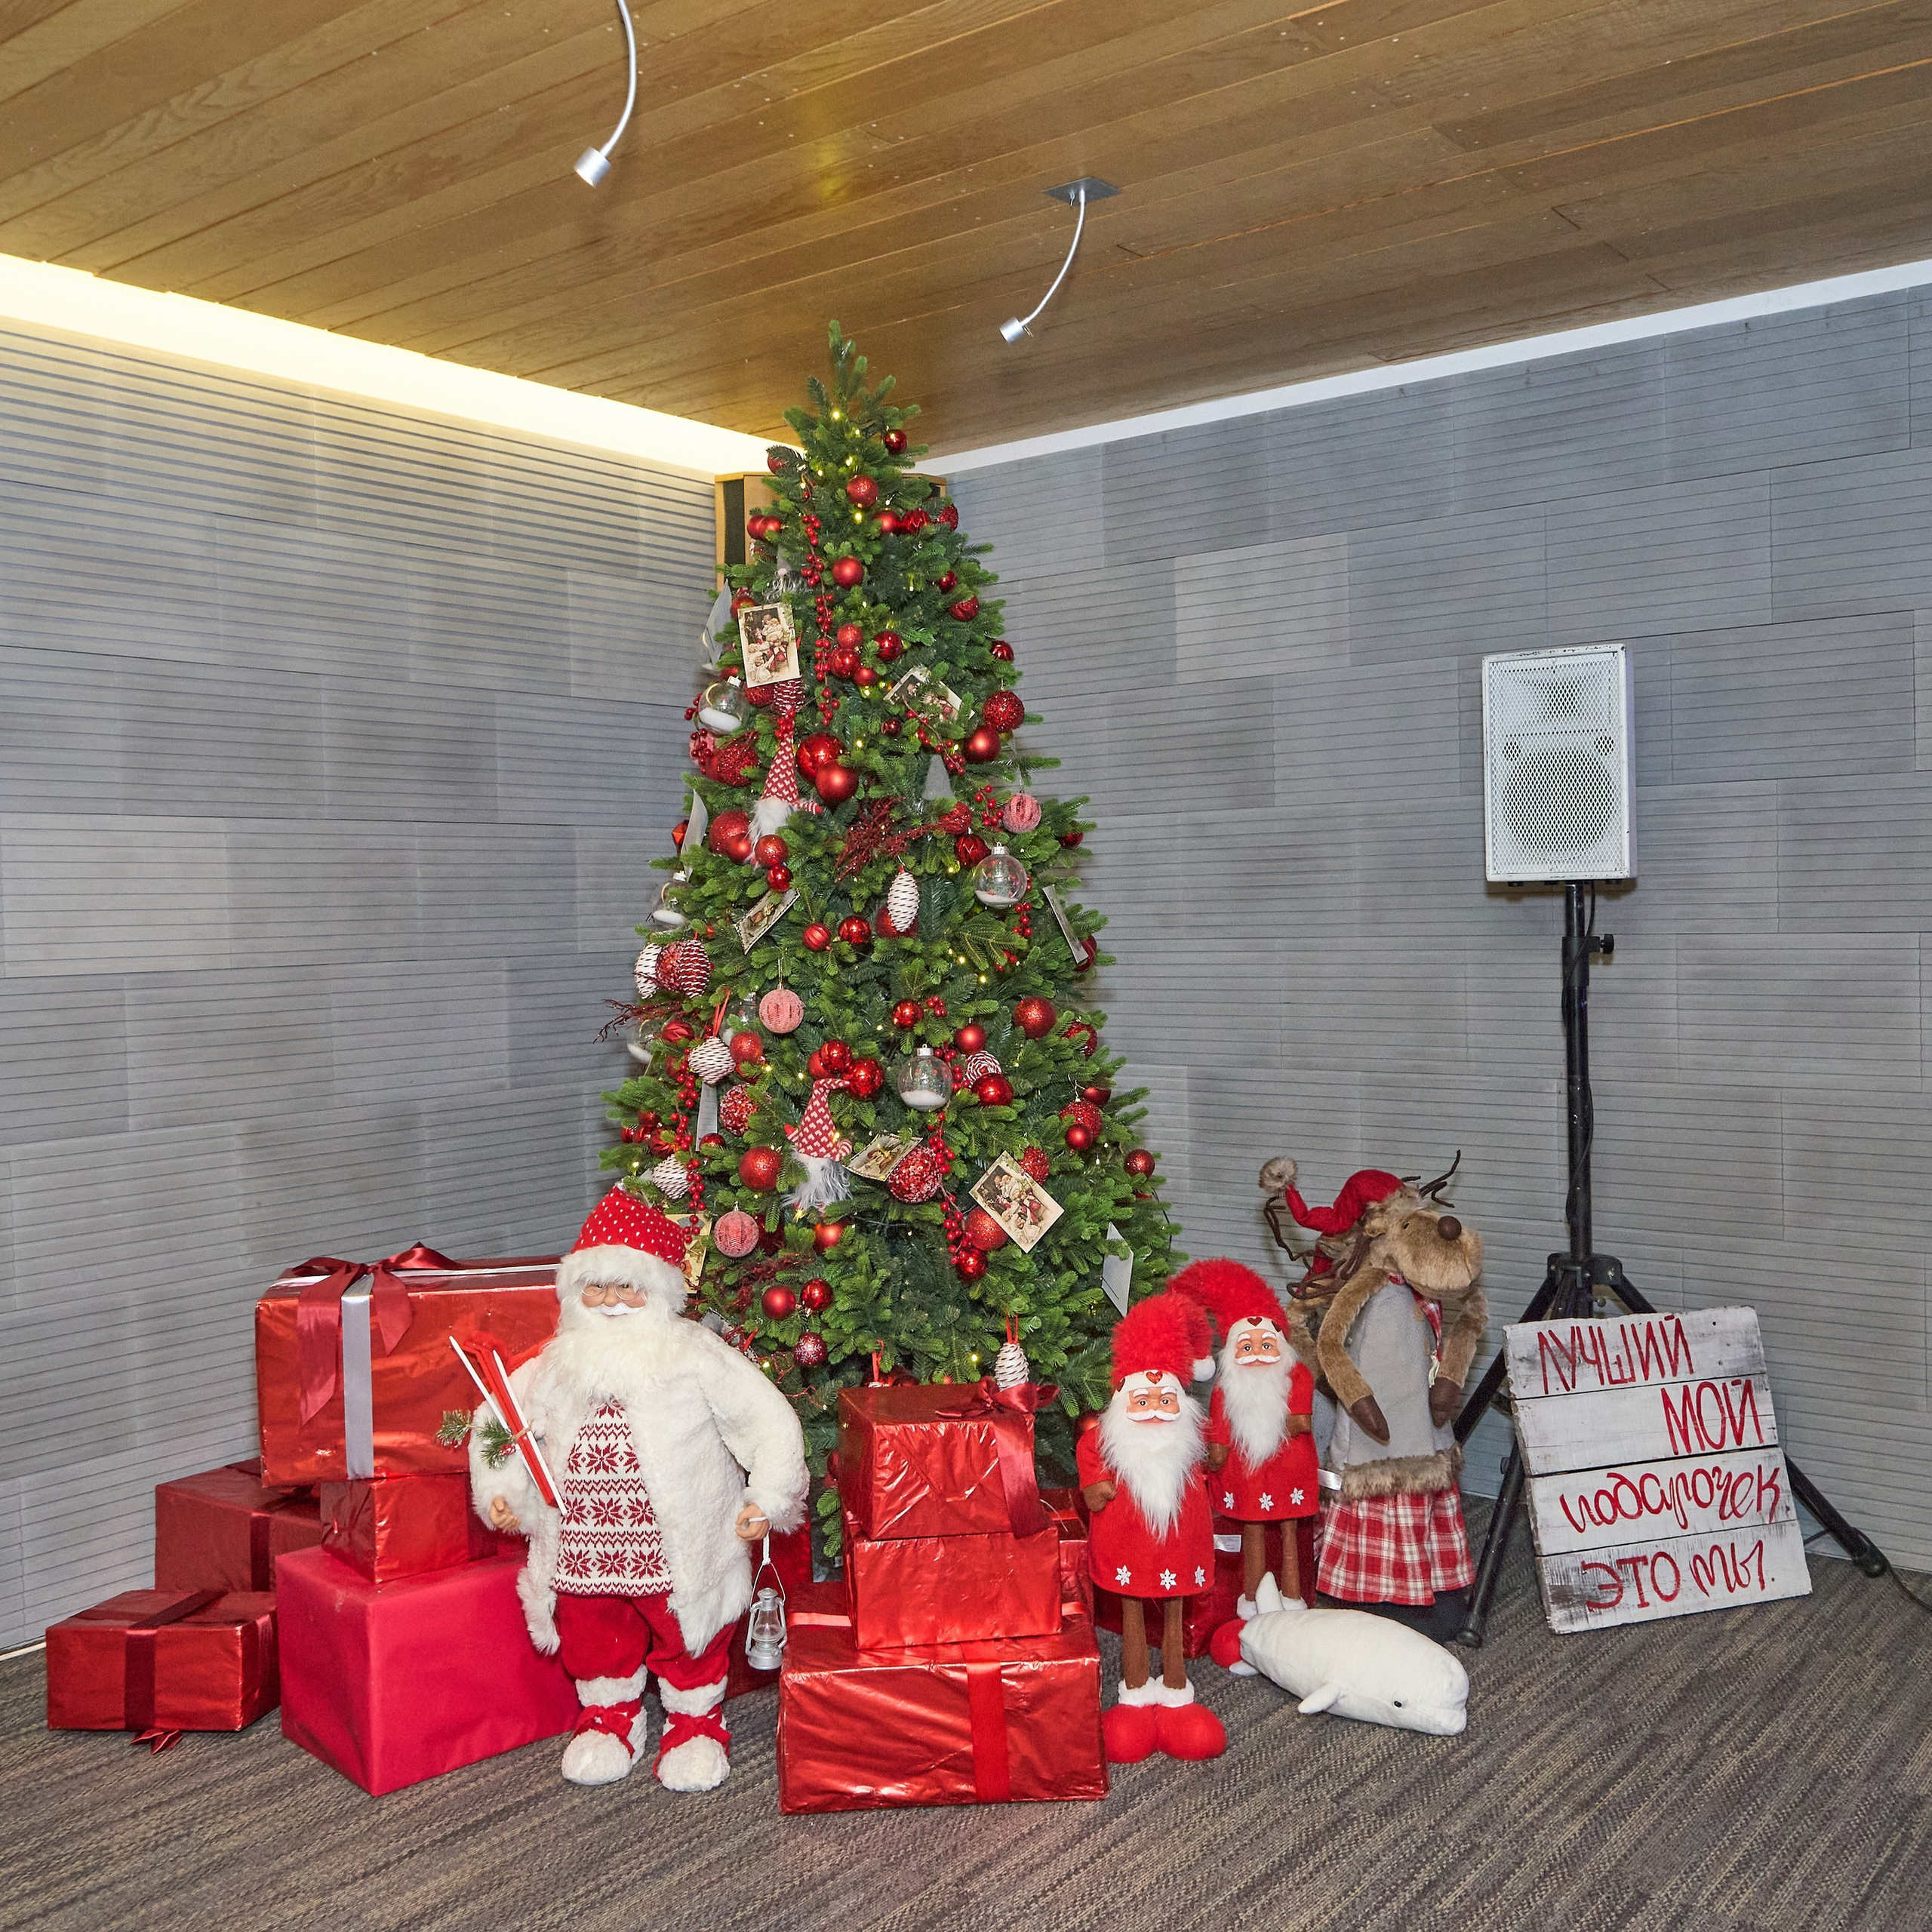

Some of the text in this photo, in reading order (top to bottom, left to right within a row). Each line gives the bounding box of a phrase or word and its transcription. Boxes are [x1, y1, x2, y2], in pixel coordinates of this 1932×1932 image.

[1537, 1315, 1694, 1395] ЛУЧШИЙ
[1660, 1379, 1764, 1455] МОЙ
[1581, 1551, 1681, 1611] ЭТО
